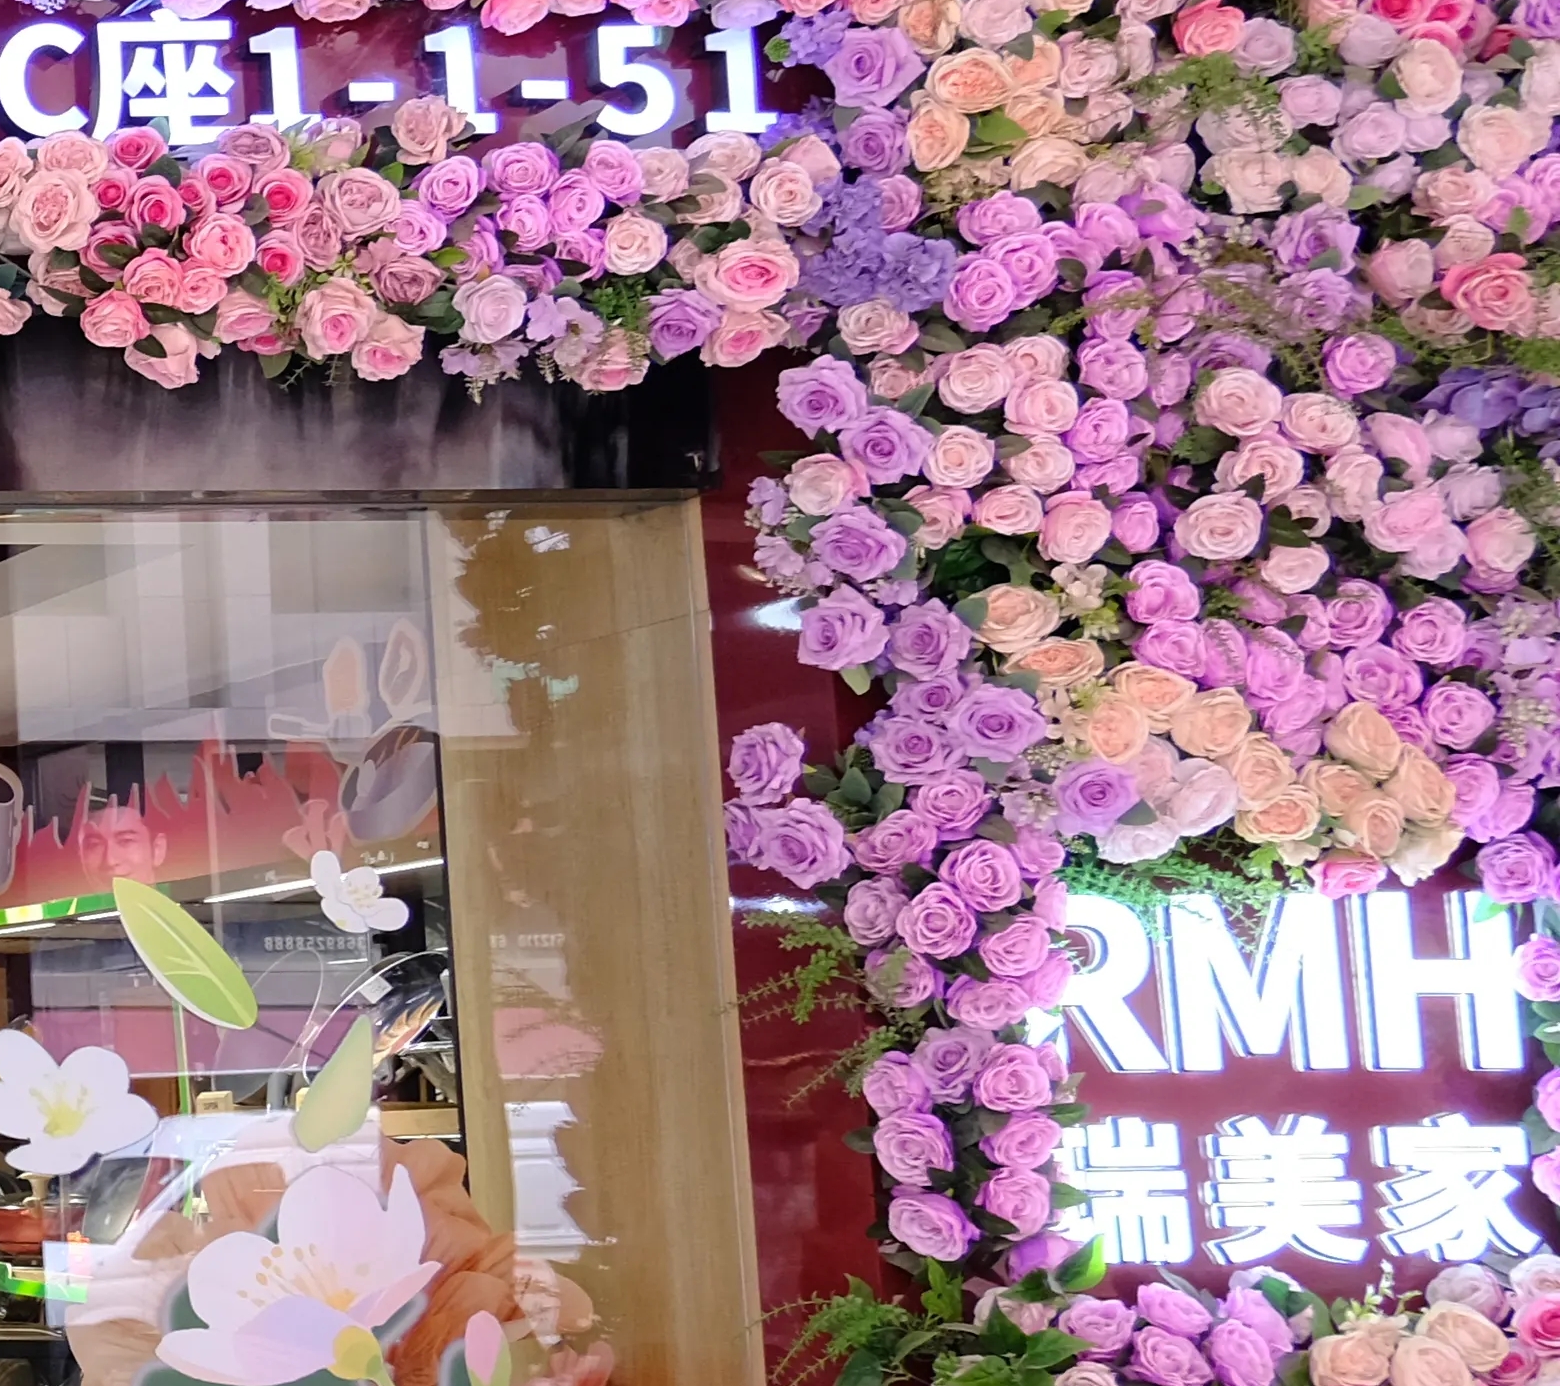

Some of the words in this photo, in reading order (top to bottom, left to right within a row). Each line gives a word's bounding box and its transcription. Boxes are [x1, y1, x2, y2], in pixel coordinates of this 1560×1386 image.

[1026, 890, 1526, 1073] RMH
[1050, 1113, 1543, 1266] 瑞美家
